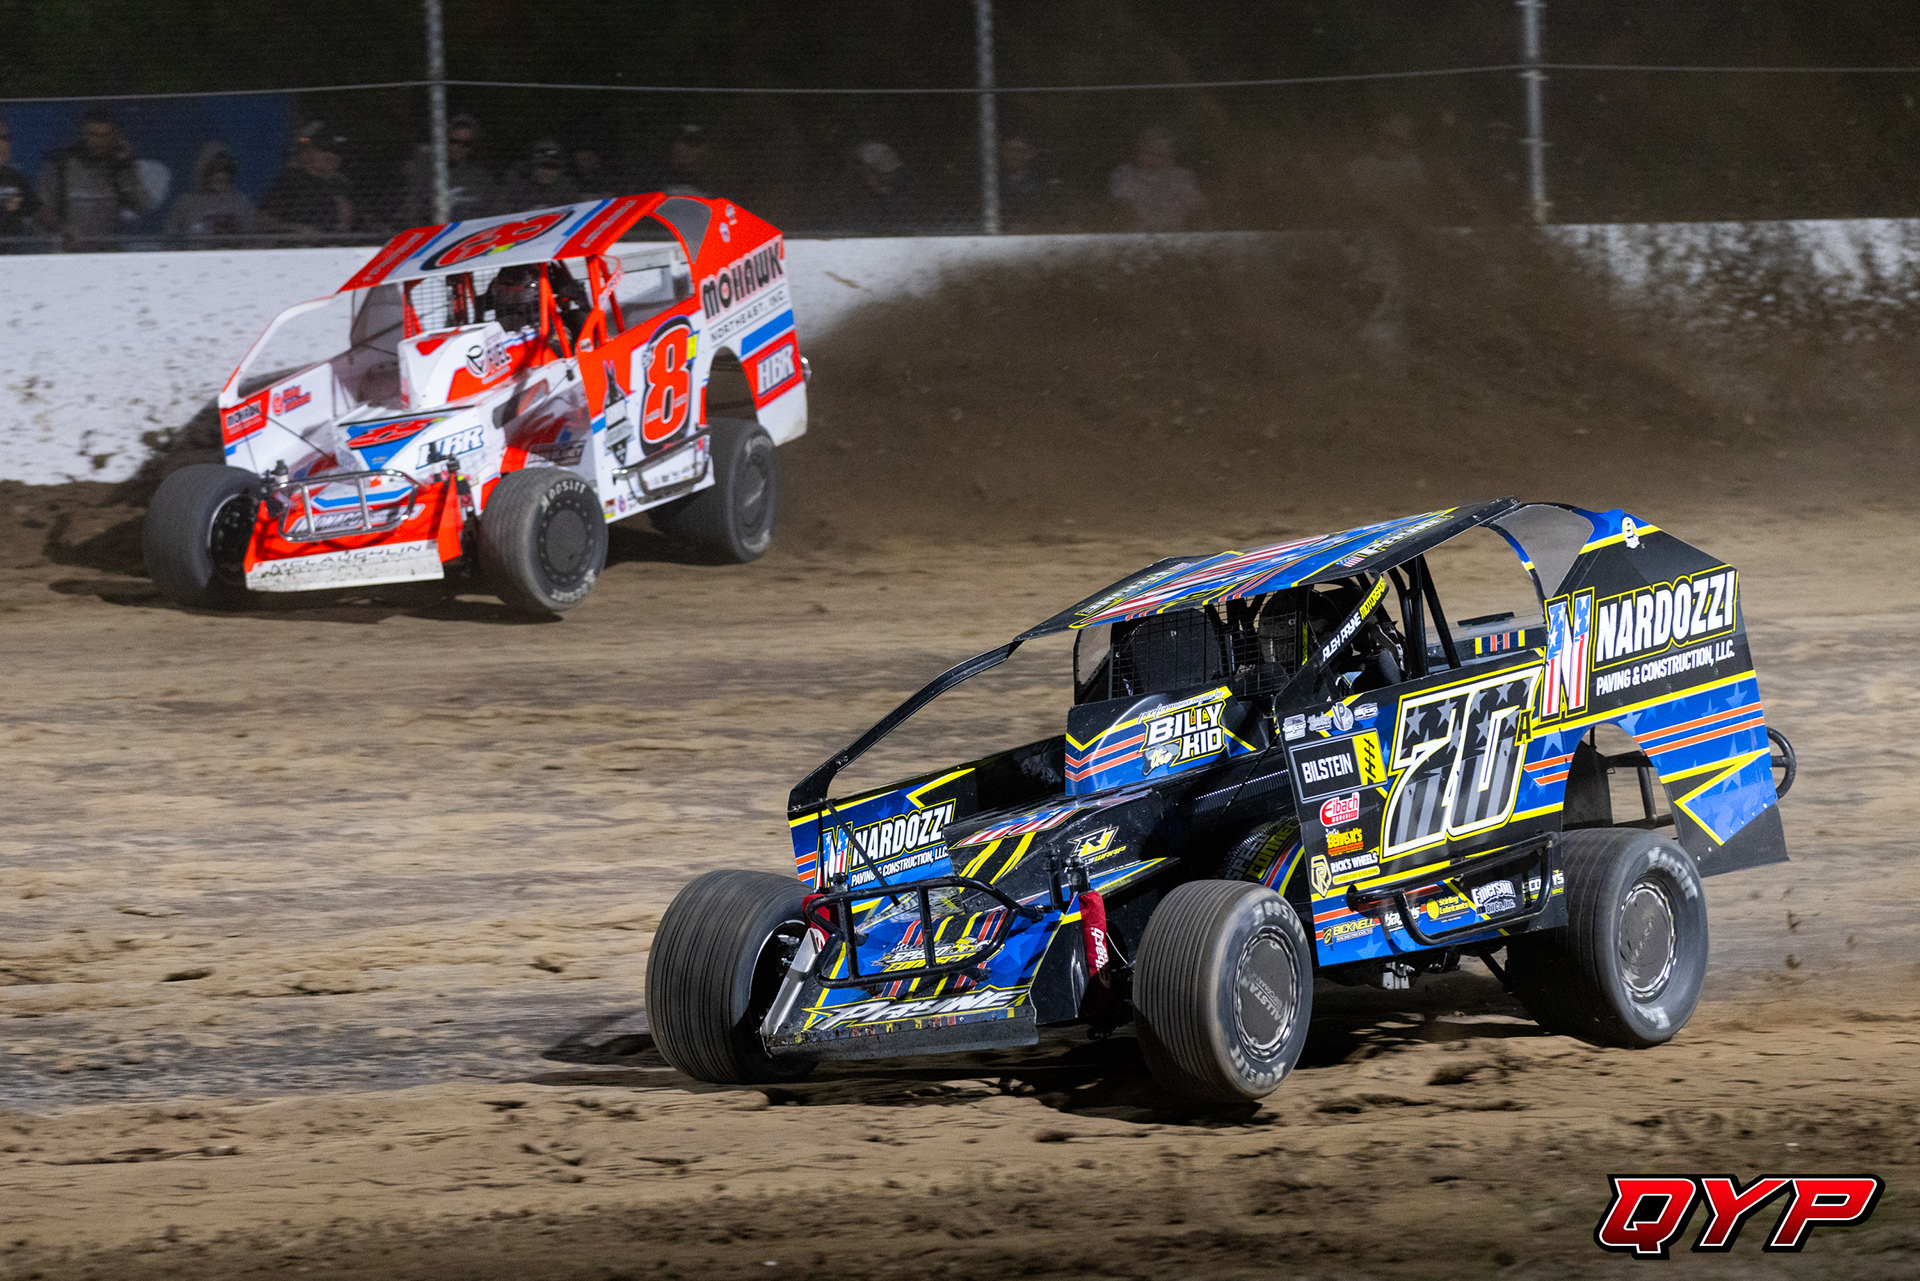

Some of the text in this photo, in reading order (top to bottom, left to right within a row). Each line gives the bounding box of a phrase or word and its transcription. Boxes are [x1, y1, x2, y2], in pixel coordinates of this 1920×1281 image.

[703, 242, 783, 319] MOHAWK
[643, 321, 692, 443] 8
[758, 344, 796, 397] HBR
[1597, 571, 1735, 662] NARDOZZI
[1596, 639, 1735, 696] PAVING & CONSTRUCTION, LLC.
[1147, 703, 1223, 746] BILLY
[1180, 727, 1222, 760] KID
[1301, 753, 1353, 783] BILSTEIN
[1321, 794, 1359, 825] Eibach
[852, 804, 953, 867] NARDOZZI
[1351, 852, 1379, 868] WHEELS
[1472, 881, 1514, 907] Emerson
[1522, 872, 1564, 894] SCOYS
[1333, 918, 1376, 936] BICKNELL
[884, 945, 953, 964] SPED
